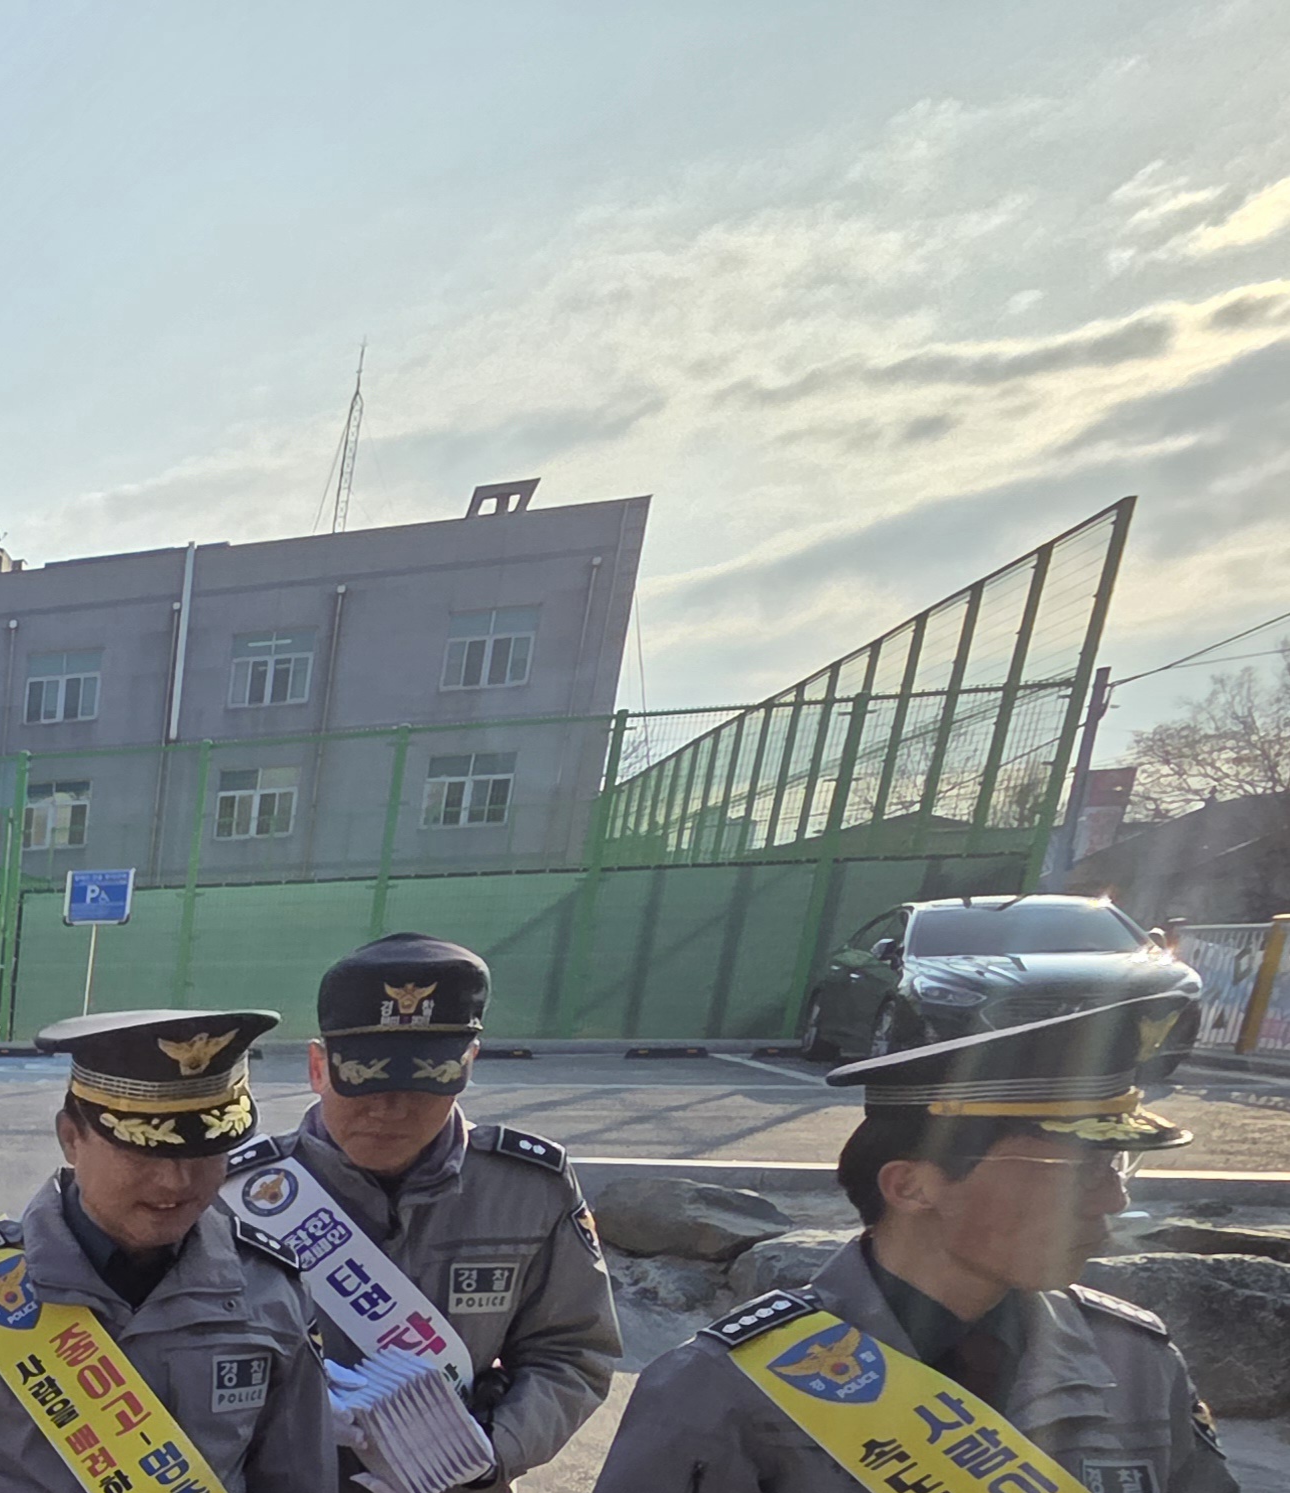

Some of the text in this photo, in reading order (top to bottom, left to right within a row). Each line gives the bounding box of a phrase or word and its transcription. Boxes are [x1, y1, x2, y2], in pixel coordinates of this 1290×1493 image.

[325, 1257, 399, 1322] 타면
[454, 1293, 507, 1310] POLICE
[15, 1353, 79, 1430] 사람을
[217, 1386, 266, 1406] POLICE
[836, 1370, 880, 1399] POLICE
